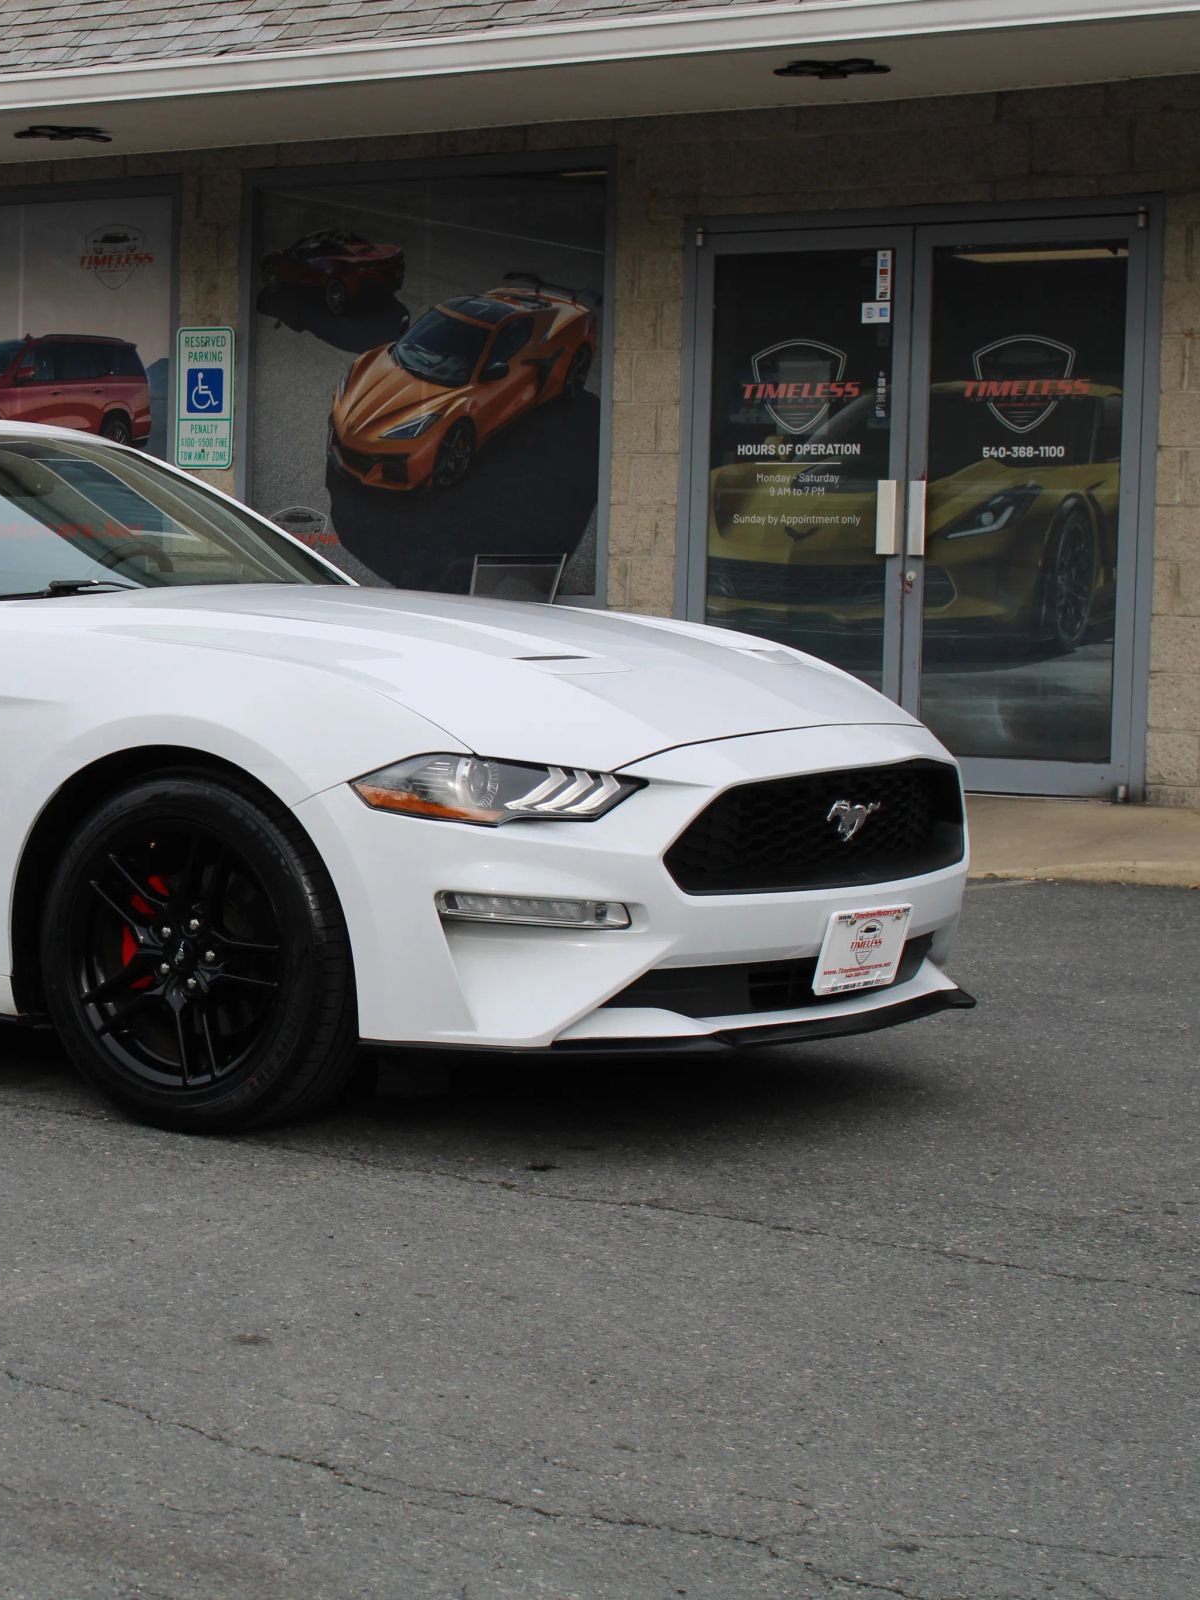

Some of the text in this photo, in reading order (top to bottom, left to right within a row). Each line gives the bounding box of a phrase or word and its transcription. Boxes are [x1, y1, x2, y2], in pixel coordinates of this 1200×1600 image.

[80, 252, 154, 267] TIMELESS
[184, 336, 226, 348] RESERVED
[188, 351, 223, 362] PARKING
[742, 381, 863, 399] TIMELESS
[963, 379, 1091, 397] TIMELESS
[190, 424, 219, 434] PENALTY
[215, 437, 228, 448] FINE
[737, 443, 860, 456] HOURS OF OPERATION
[982, 446, 1065, 458] 540-368-1100
[180, 451, 227, 461] TOW AWAY ZONE
[756, 473, 791, 484] Monday
[798, 473, 840, 484] Saturday
[769, 487, 825, 496] 9 AM to 7 PM
[733, 514, 861, 526] Sunday by Appointment only
[850, 939, 882, 950] TIMELESS
